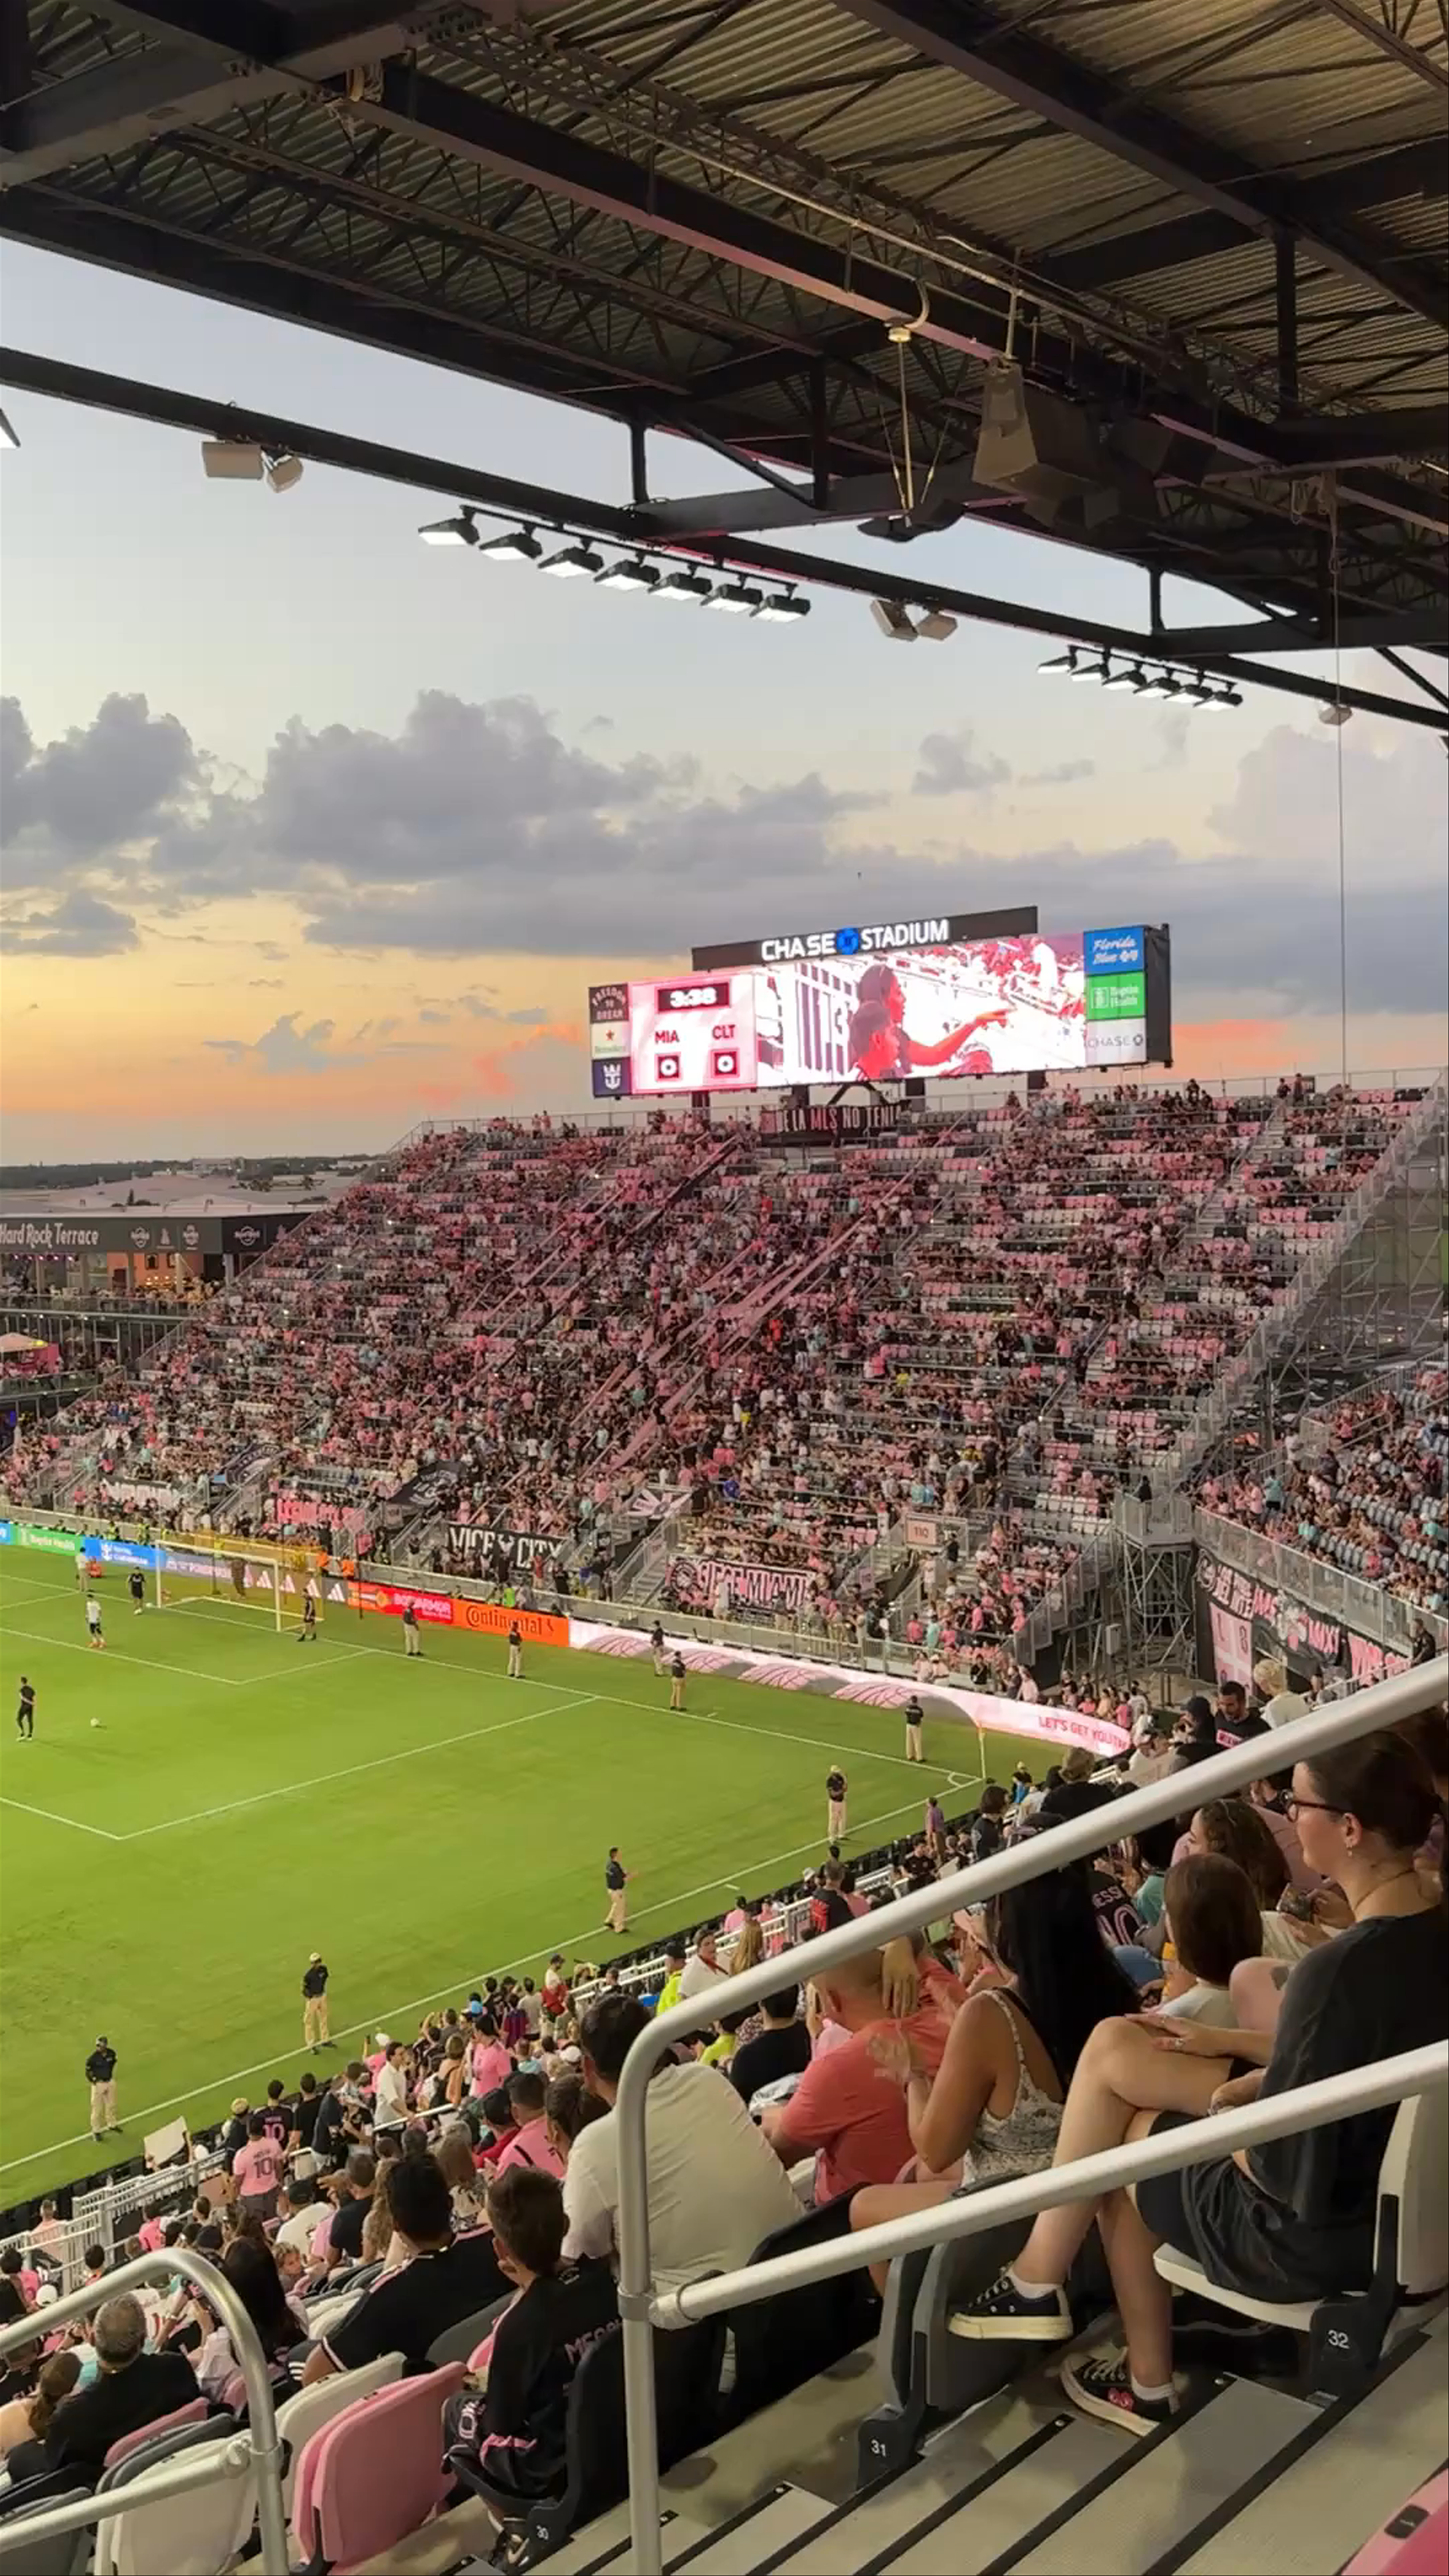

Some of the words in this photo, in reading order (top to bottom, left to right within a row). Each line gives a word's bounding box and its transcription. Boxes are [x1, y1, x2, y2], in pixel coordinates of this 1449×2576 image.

[761, 933, 837, 961] CHASE
[861, 919, 949, 950] STADIUM
[655, 1030, 679, 1044] MIA
[712, 1024, 735, 1040] CLT
[1087, 1036, 1131, 1048] CHASE
[660, 1058, 677, 1076] 0
[717, 1054, 734, 1072] 0
[792, 1109, 806, 1132] LA
[811, 1107, 837, 1130] MLS
[842, 1107, 860, 1128] NO
[0, 1223, 25, 1244] Hard
[26, 1223, 53, 1249] Rock
[54, 1223, 98, 1245] Terrace
[449, 1527, 495, 1559] VICE
[517, 1536, 563, 1569] CITY
[747, 1569, 808, 1609] MIAMI
[466, 1605, 542, 1635] Continntal
[1039, 1716, 1068, 1732] LET'S
[1071, 1722, 1088, 1735] GET
[1092, 1885, 1124, 1908] ESSI
[262, 2123, 285, 2141] 10
[254, 2156, 273, 2179] 10
[1328, 2329, 1350, 2350] 32
[871, 2439, 886, 2457] 31
